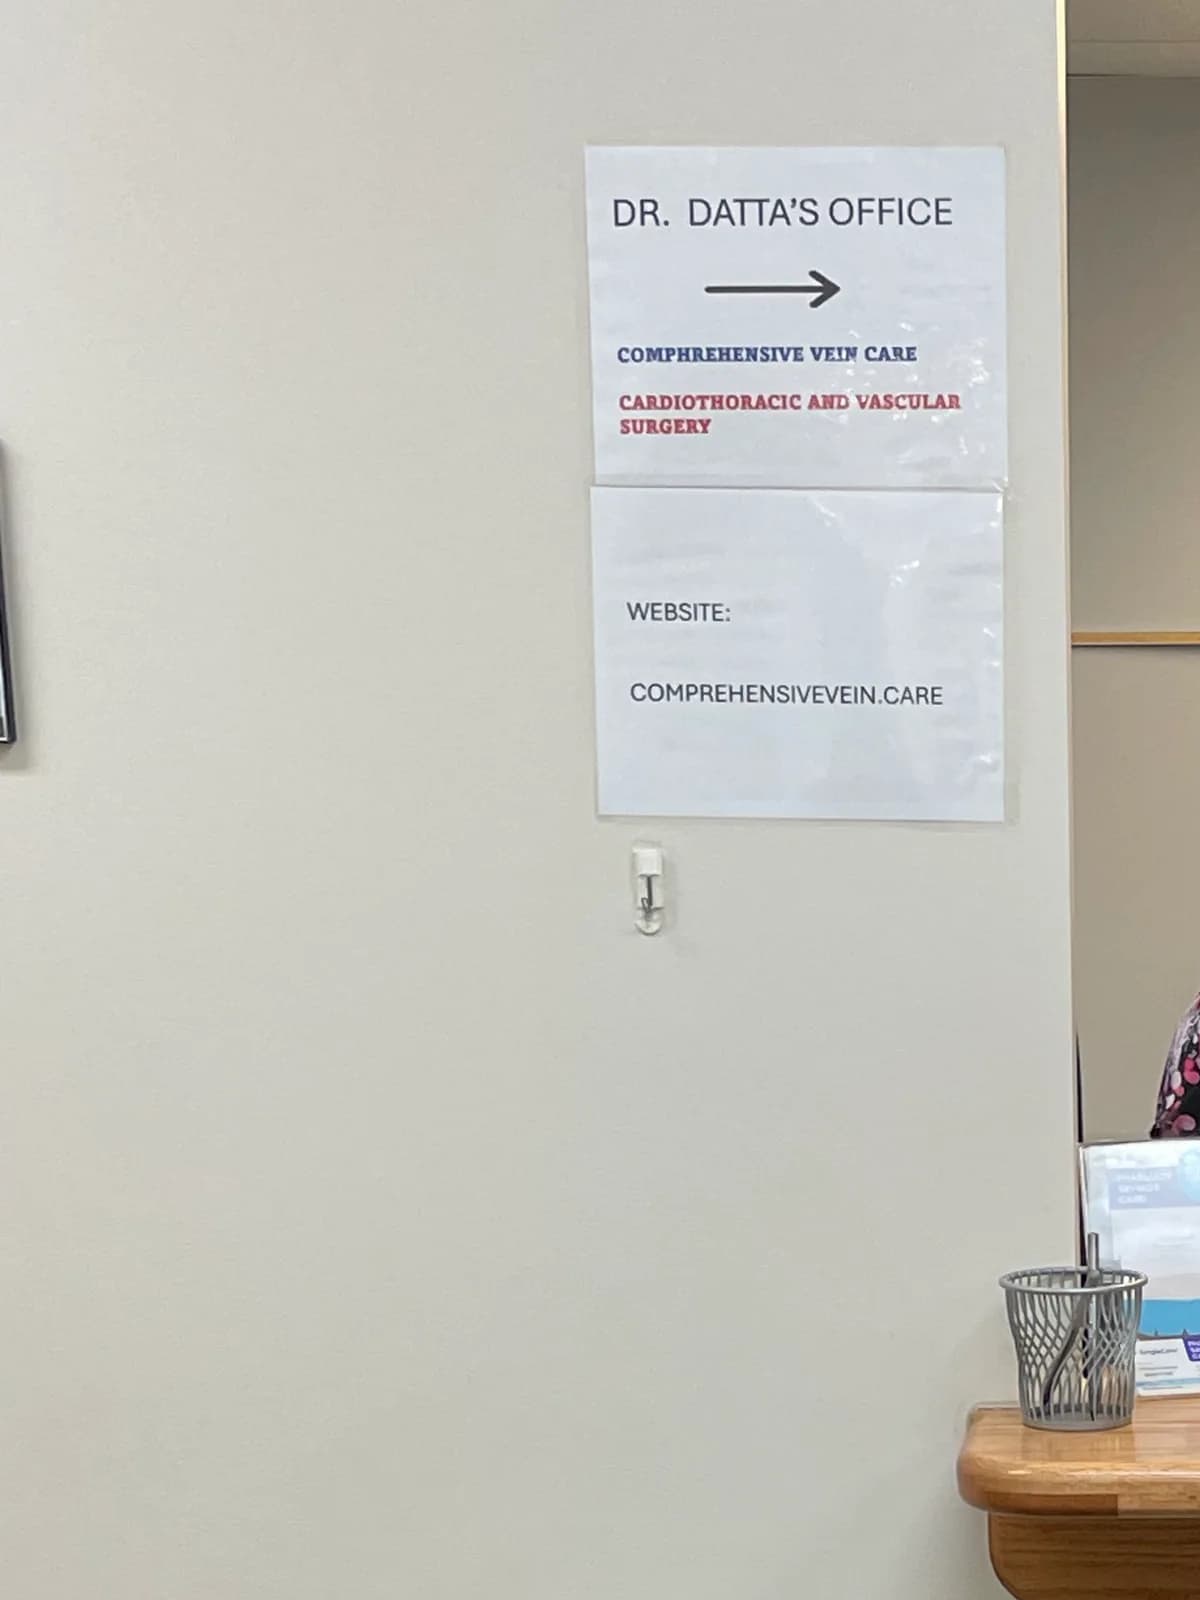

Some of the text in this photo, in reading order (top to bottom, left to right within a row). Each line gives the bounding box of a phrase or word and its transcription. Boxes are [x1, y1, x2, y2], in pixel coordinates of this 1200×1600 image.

[613, 196, 953, 228] DR. DATTA'S OFFICE
[617, 346, 918, 364] COMPHREHENSIVE VEIN CARE
[619, 394, 961, 411] CARDIOTHORACIC AND VASCULAR
[620, 418, 712, 435] SURGERY
[626, 602, 731, 622] WEBSITE:
[630, 683, 944, 706] COMPREHENSIVEVEIN.CARE
